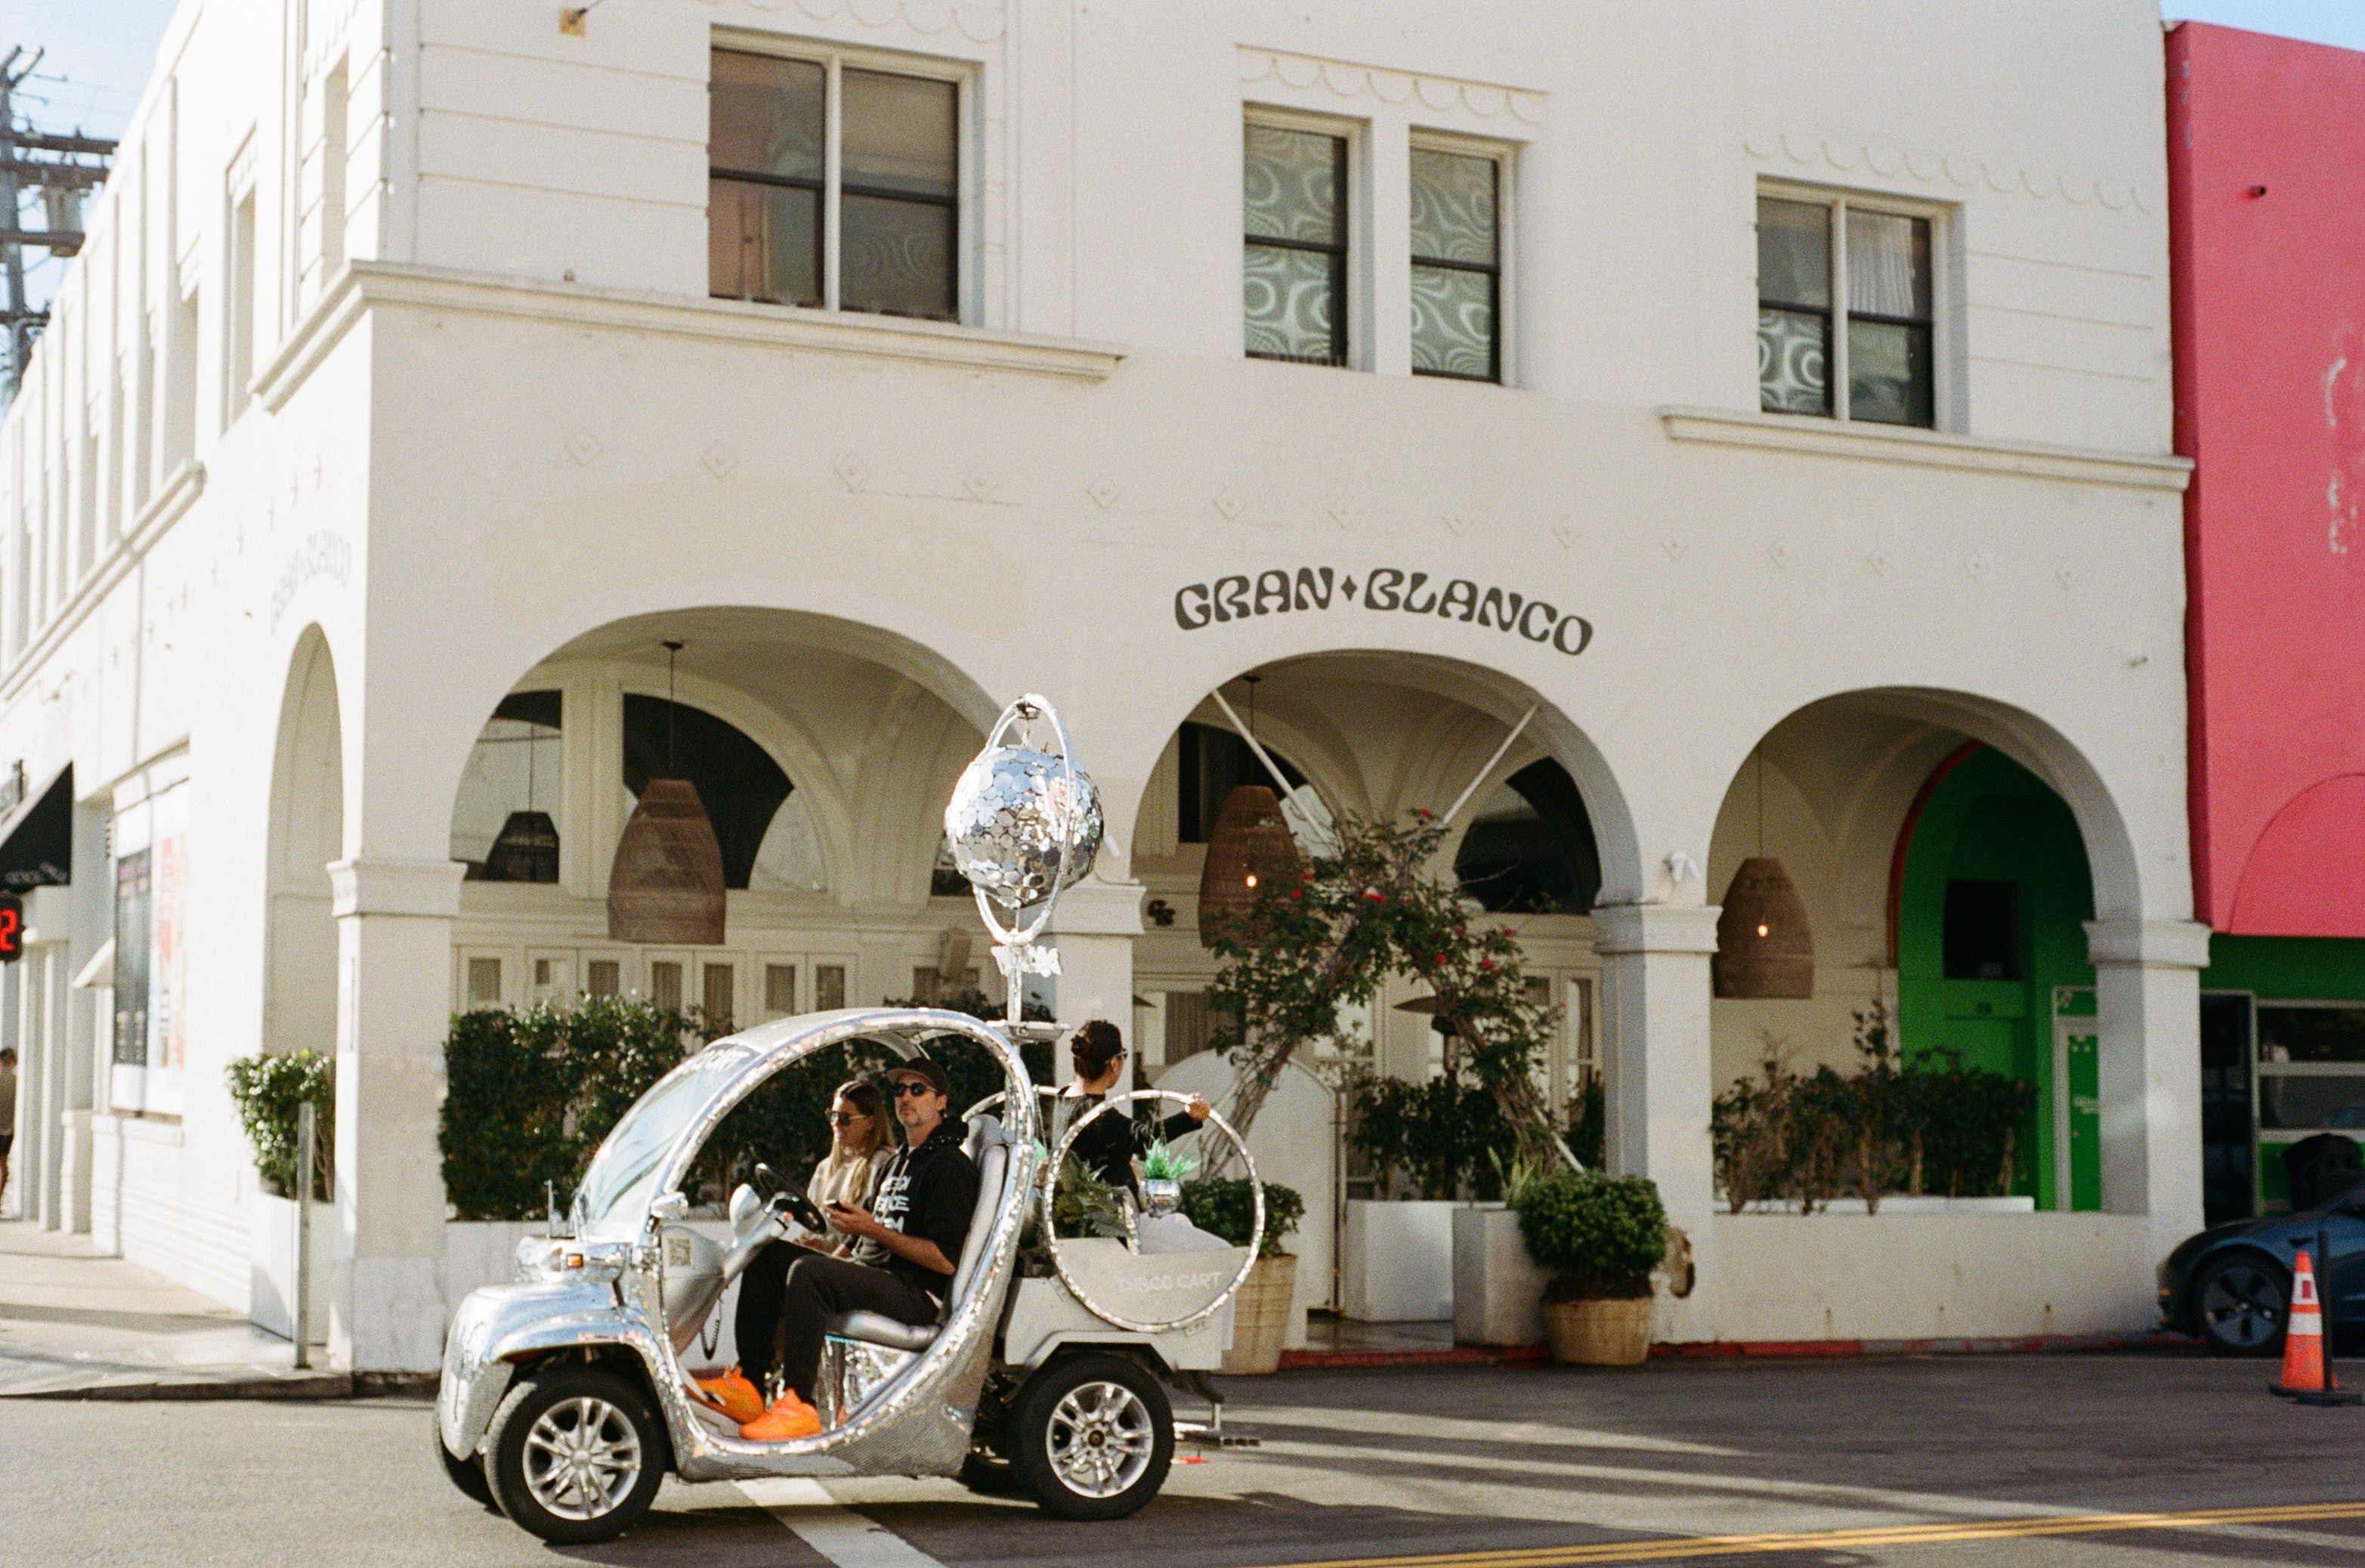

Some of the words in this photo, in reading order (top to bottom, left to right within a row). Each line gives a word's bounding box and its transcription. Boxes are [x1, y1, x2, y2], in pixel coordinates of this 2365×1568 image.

[1174, 567, 1334, 631] GRAN
[1364, 568, 1594, 656] BLANCO
[1176, 1271, 1223, 1290] CART
